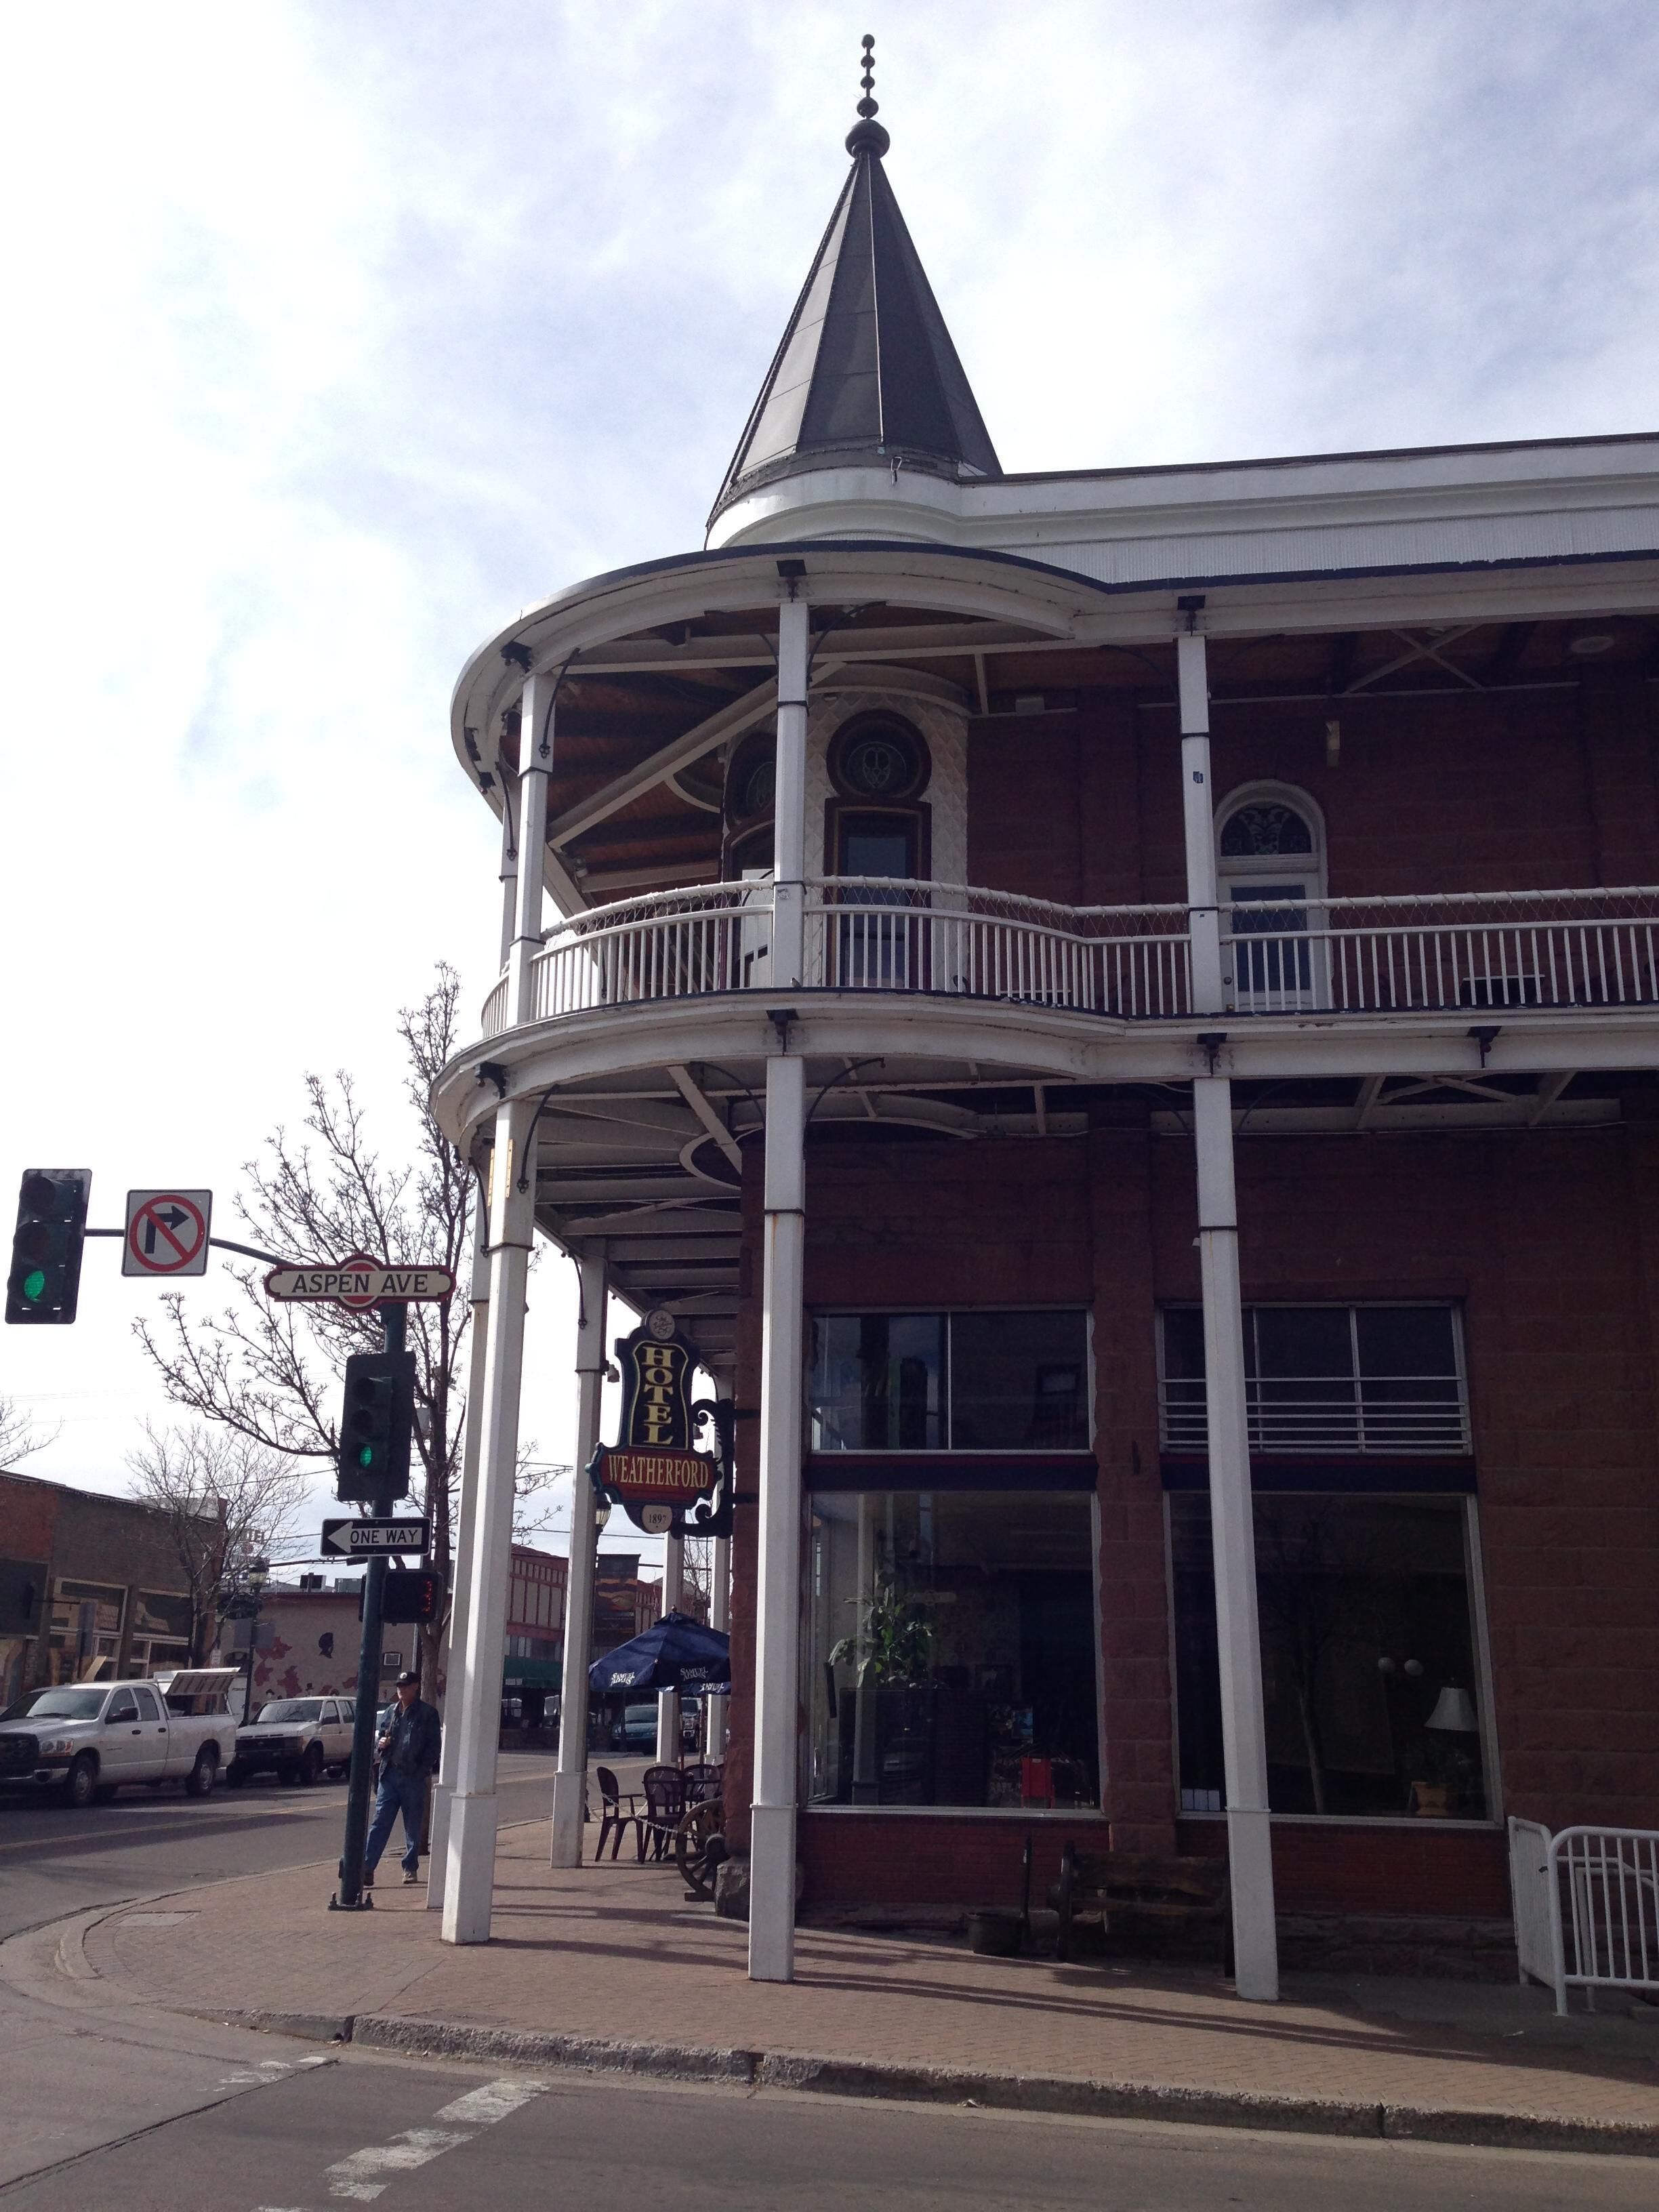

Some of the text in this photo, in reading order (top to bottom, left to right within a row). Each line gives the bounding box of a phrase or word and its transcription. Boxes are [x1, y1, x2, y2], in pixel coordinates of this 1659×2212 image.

[291, 1273, 428, 1293] ASPEN AVE
[642, 1347, 675, 1445] HOTEL
[608, 1454, 709, 1488] WEATHERFORD
[350, 1530, 418, 1544] ONE WAY
